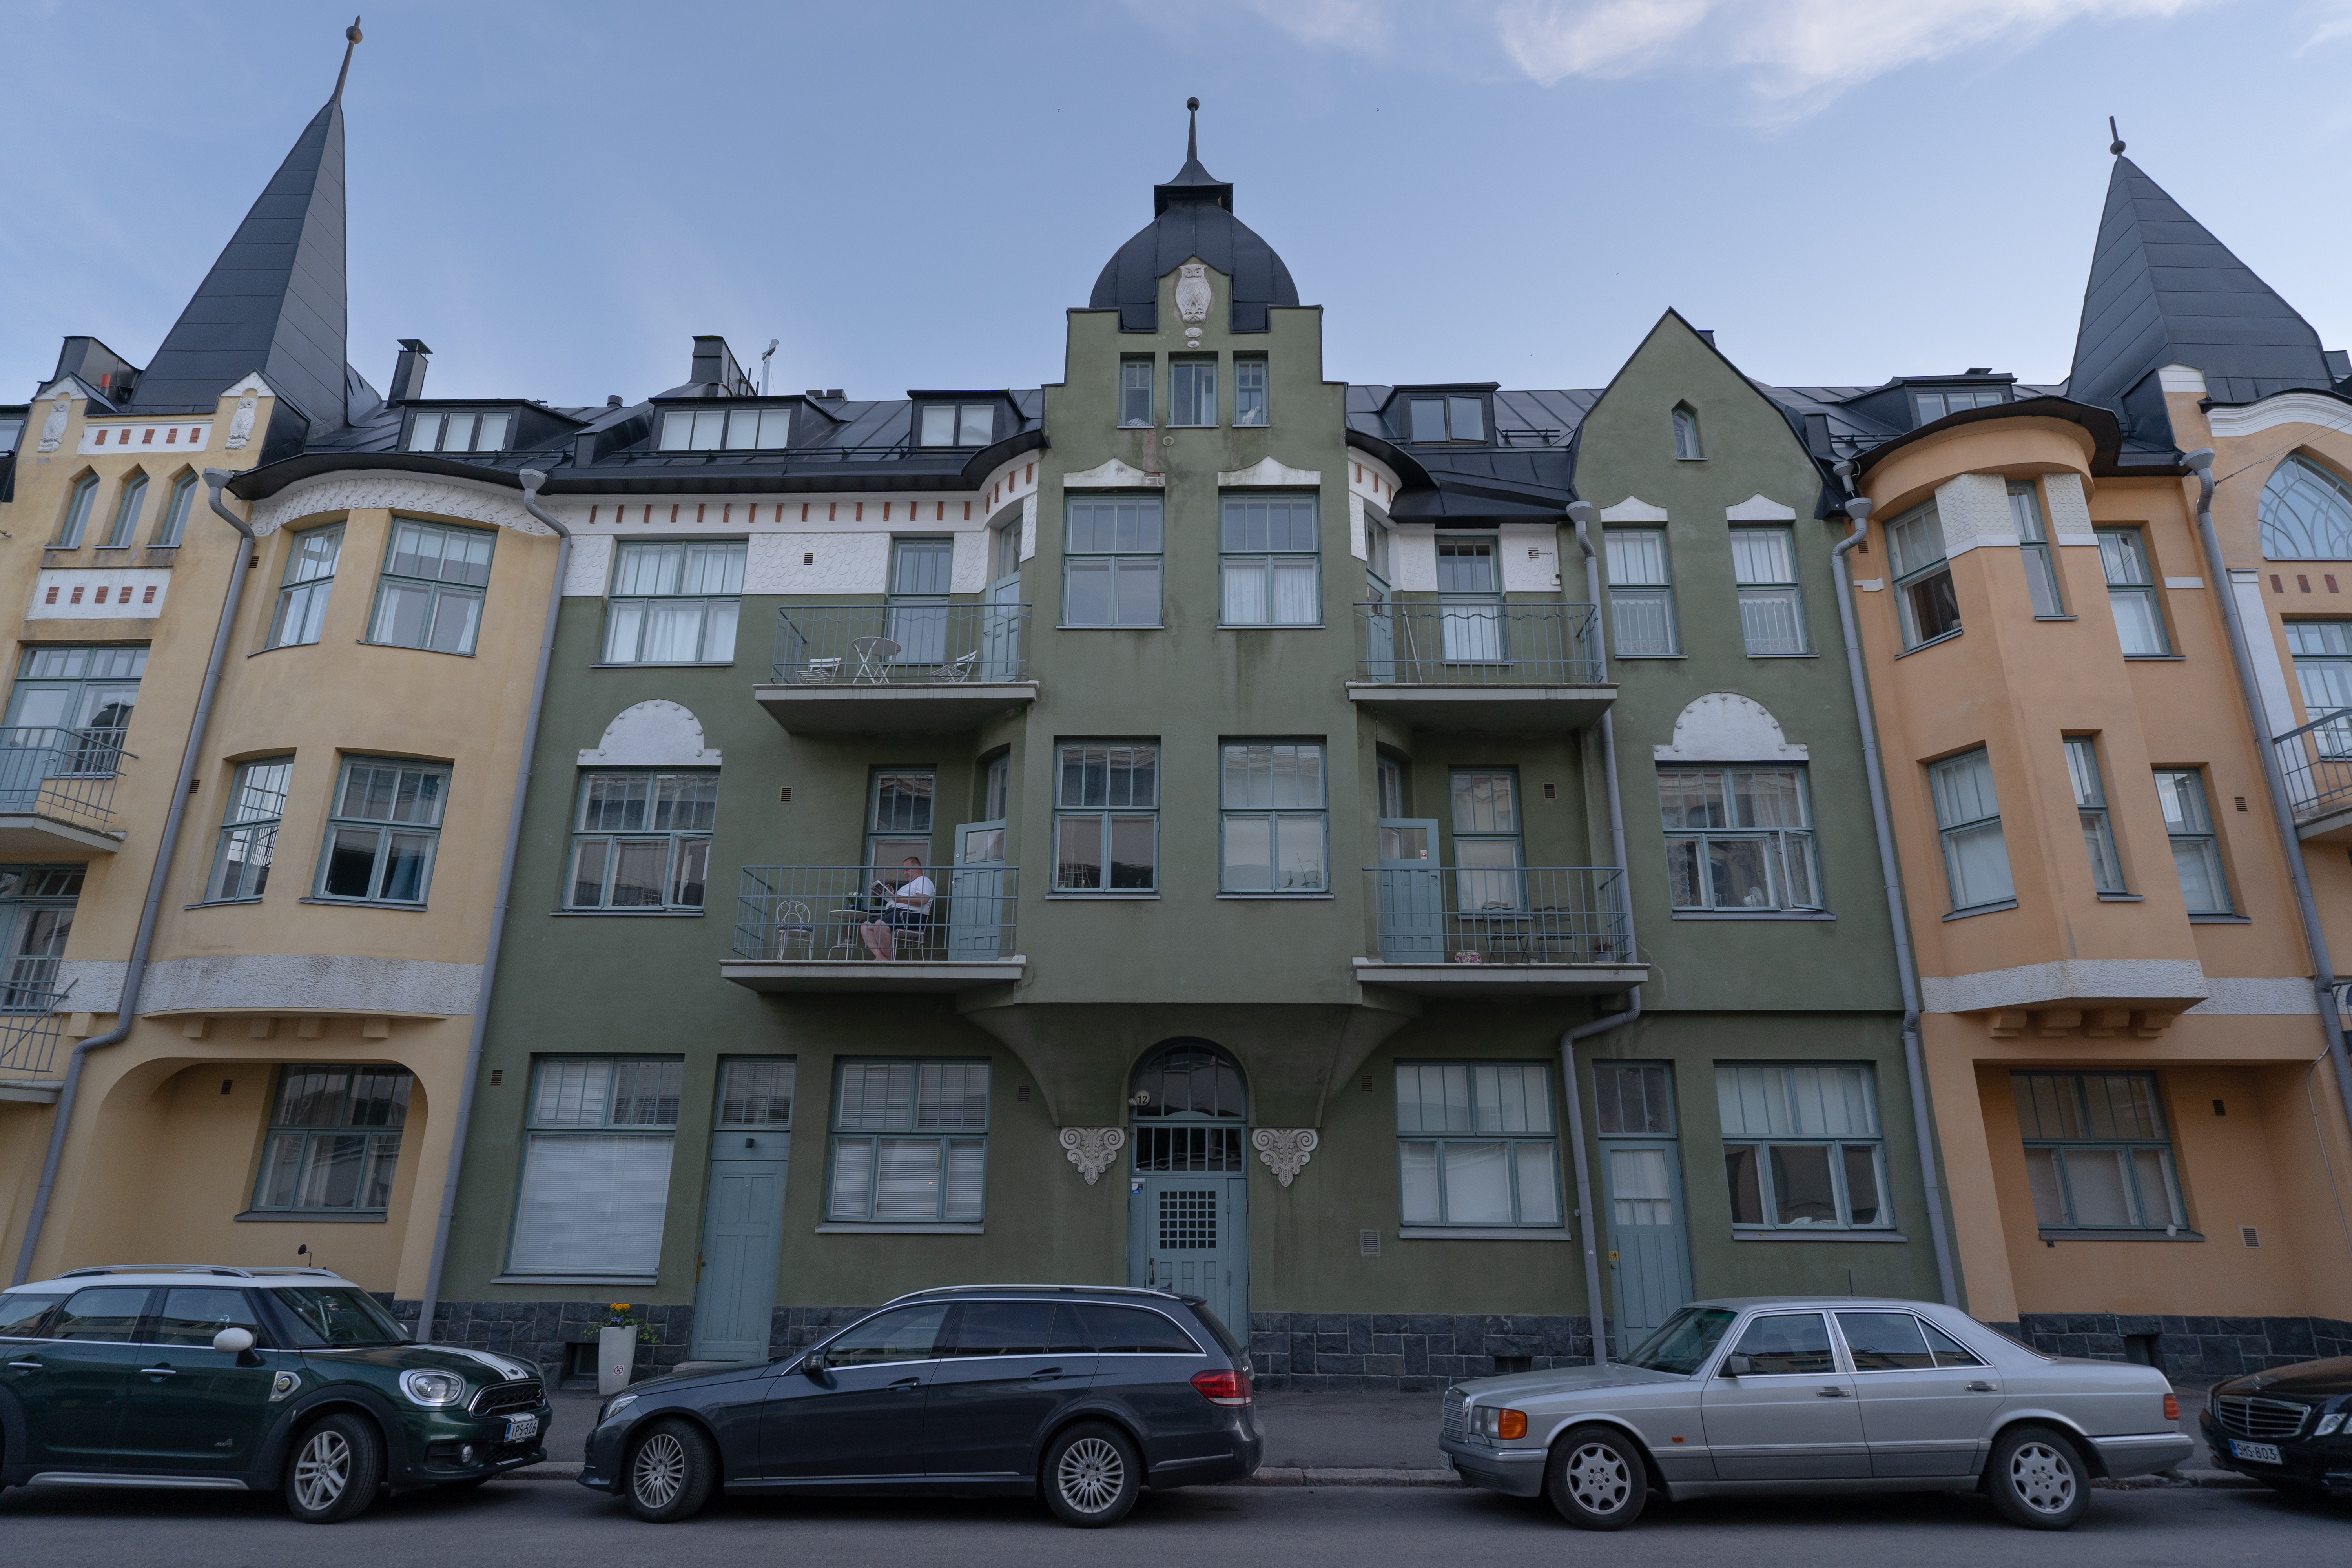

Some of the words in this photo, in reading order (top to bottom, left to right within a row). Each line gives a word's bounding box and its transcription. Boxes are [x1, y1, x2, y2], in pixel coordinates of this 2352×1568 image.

[1138, 1095, 1147, 1104] 12
[511, 1422, 537, 1437] IPS-526
[2237, 1443, 2276, 1460] SMS-803
